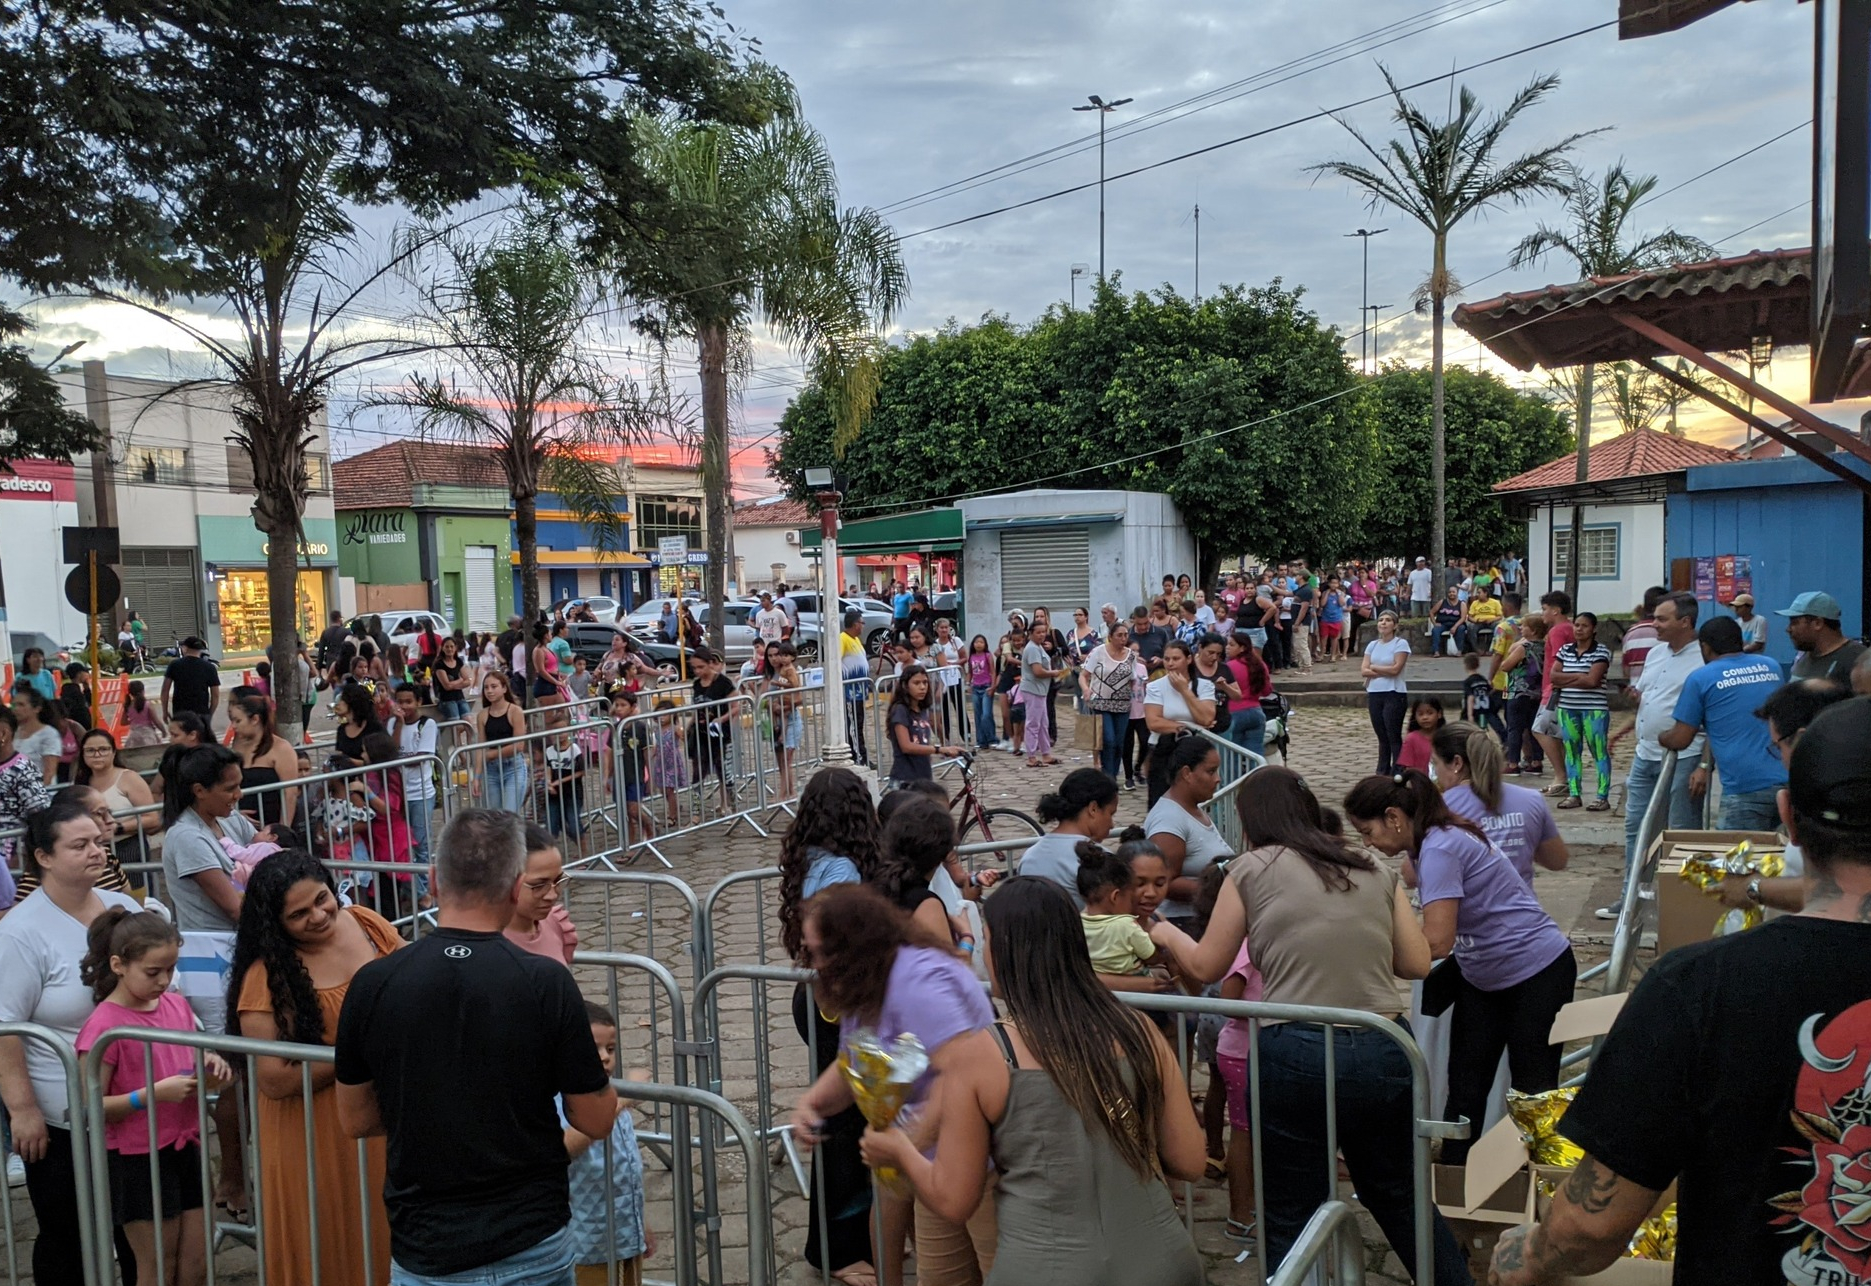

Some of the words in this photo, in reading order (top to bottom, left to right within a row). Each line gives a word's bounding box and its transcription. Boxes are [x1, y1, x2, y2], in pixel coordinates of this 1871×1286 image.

[0, 475, 52, 492] adesco
[369, 533, 406, 544] VARIEDADES
[1722, 663, 1769, 678] COMISSÃO
[1716, 673, 1780, 690] ORGANIZADORA
[1480, 812, 1525, 831] BONITO
